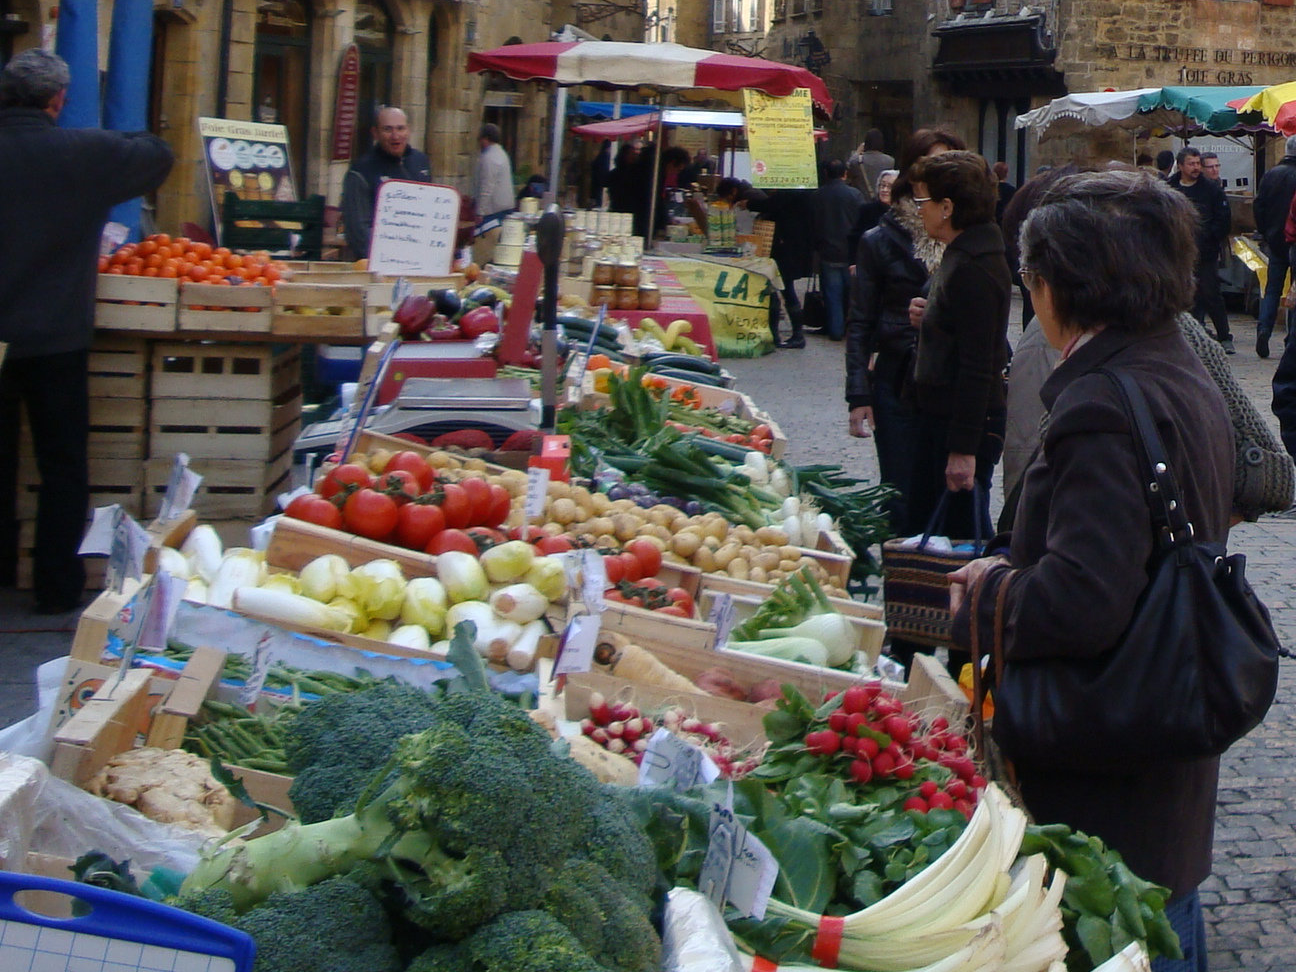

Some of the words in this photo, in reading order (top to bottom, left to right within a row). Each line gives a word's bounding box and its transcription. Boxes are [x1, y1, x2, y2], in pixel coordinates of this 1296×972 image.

[1109, 44, 1119, 59] A
[1128, 44, 1147, 60] LA
[1154, 46, 1208, 64] TRUFFE
[1214, 48, 1233, 65] DU
[1217, 69, 1253, 85] GRAS
